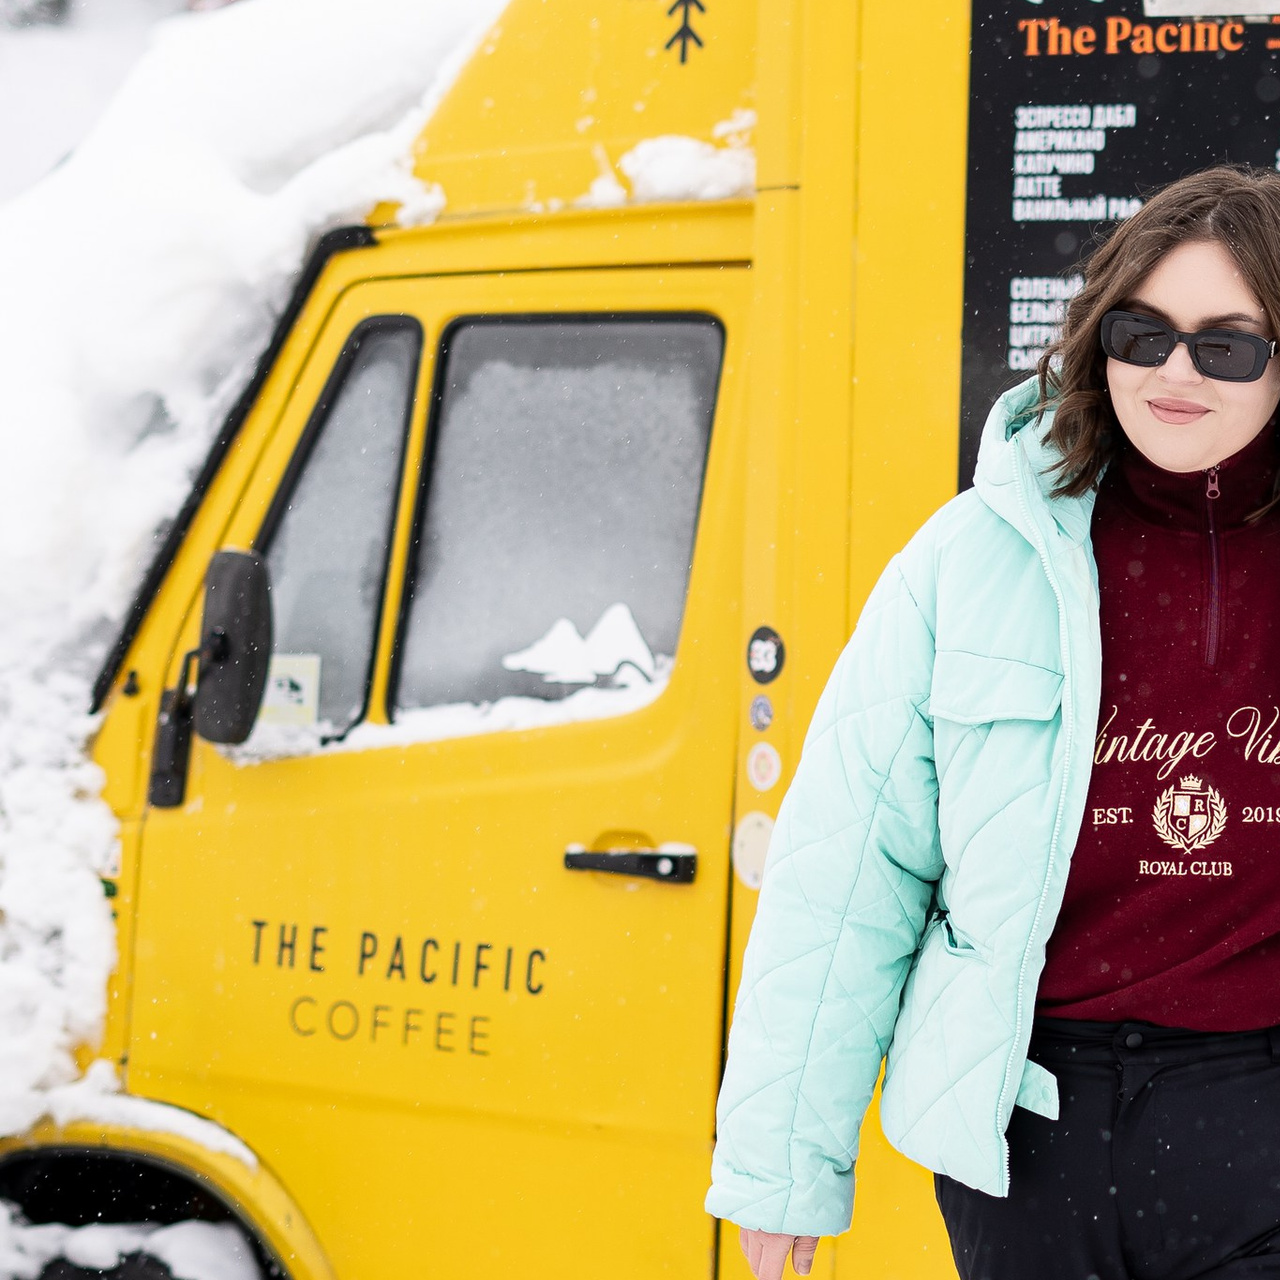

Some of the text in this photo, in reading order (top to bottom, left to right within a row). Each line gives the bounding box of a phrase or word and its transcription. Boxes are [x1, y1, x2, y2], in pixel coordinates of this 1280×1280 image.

[1018, 17, 1096, 56] The
[1014, 106, 1092, 129] ЭСПРЕССО
[1092, 104, 1136, 129] ДАБЛ
[1014, 129, 1106, 152] АМЕРИКАНО
[1014, 152, 1094, 174] КАПУЧИНО
[1013, 175, 1062, 198] ЛАТТЕ
[1012, 194, 1107, 221] ВАНИЛЬНЫЙ
[1092, 807, 1134, 824] EST.
[1194, 799, 1205, 812] R
[1176, 818, 1187, 831] C
[1139, 860, 1233, 876] ROYAL CLUB
[252, 920, 546, 995] THE PACIFIC
[288, 995, 492, 1057] COFFEE
